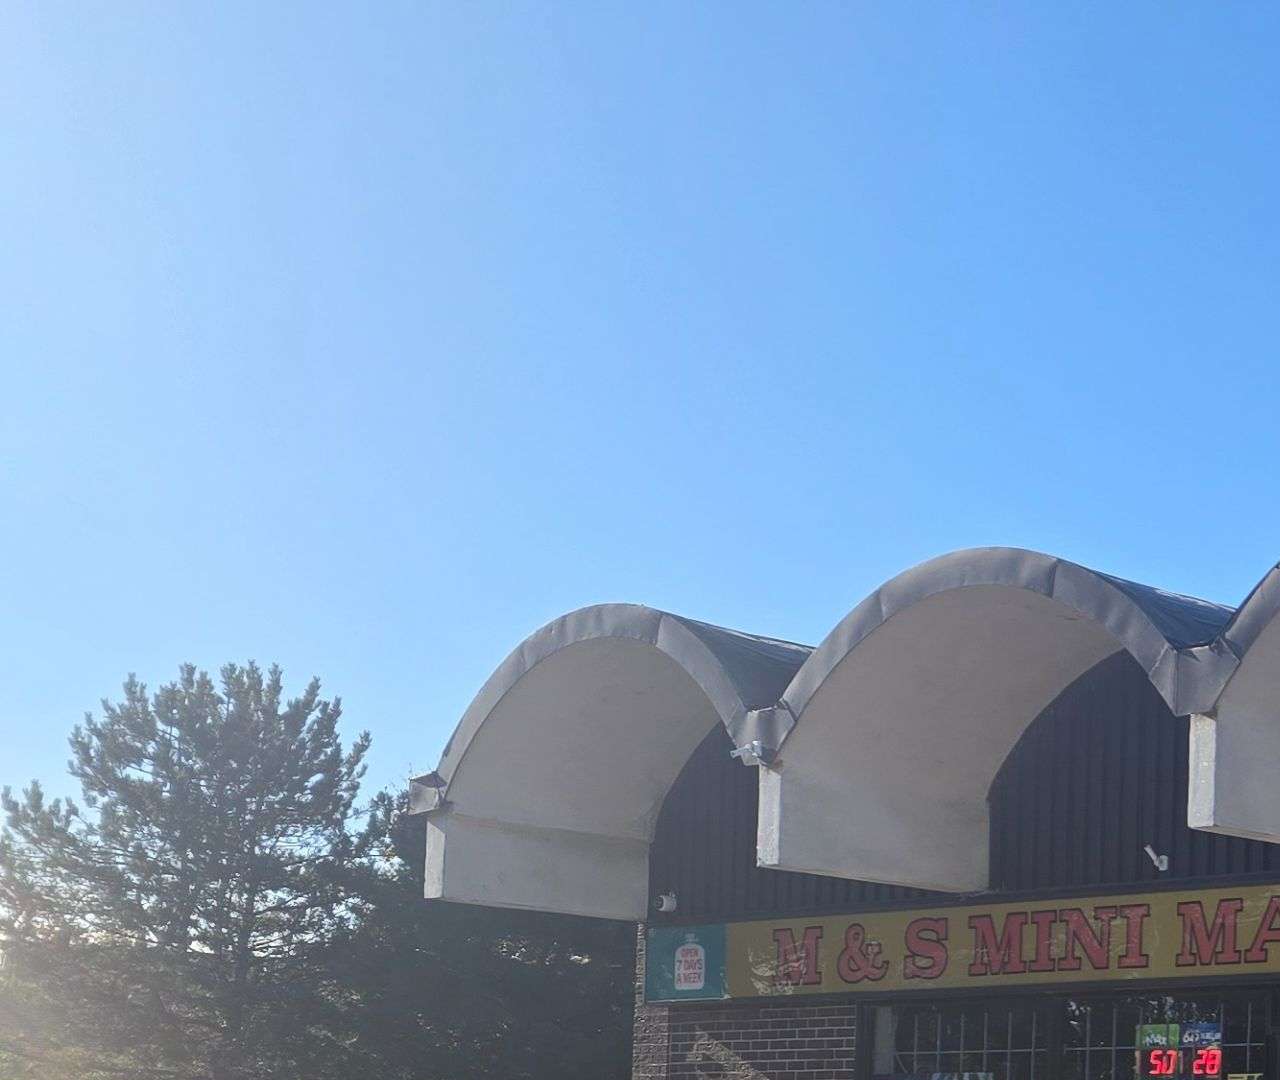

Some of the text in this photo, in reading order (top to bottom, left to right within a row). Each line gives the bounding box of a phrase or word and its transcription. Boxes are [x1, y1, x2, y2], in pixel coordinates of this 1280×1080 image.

[680, 948, 699, 959] OPEN
[772, 926, 824, 987] M
[836, 922, 890, 984] &
[903, 917, 950, 980] S
[968, 903, 1152, 977] MINI
